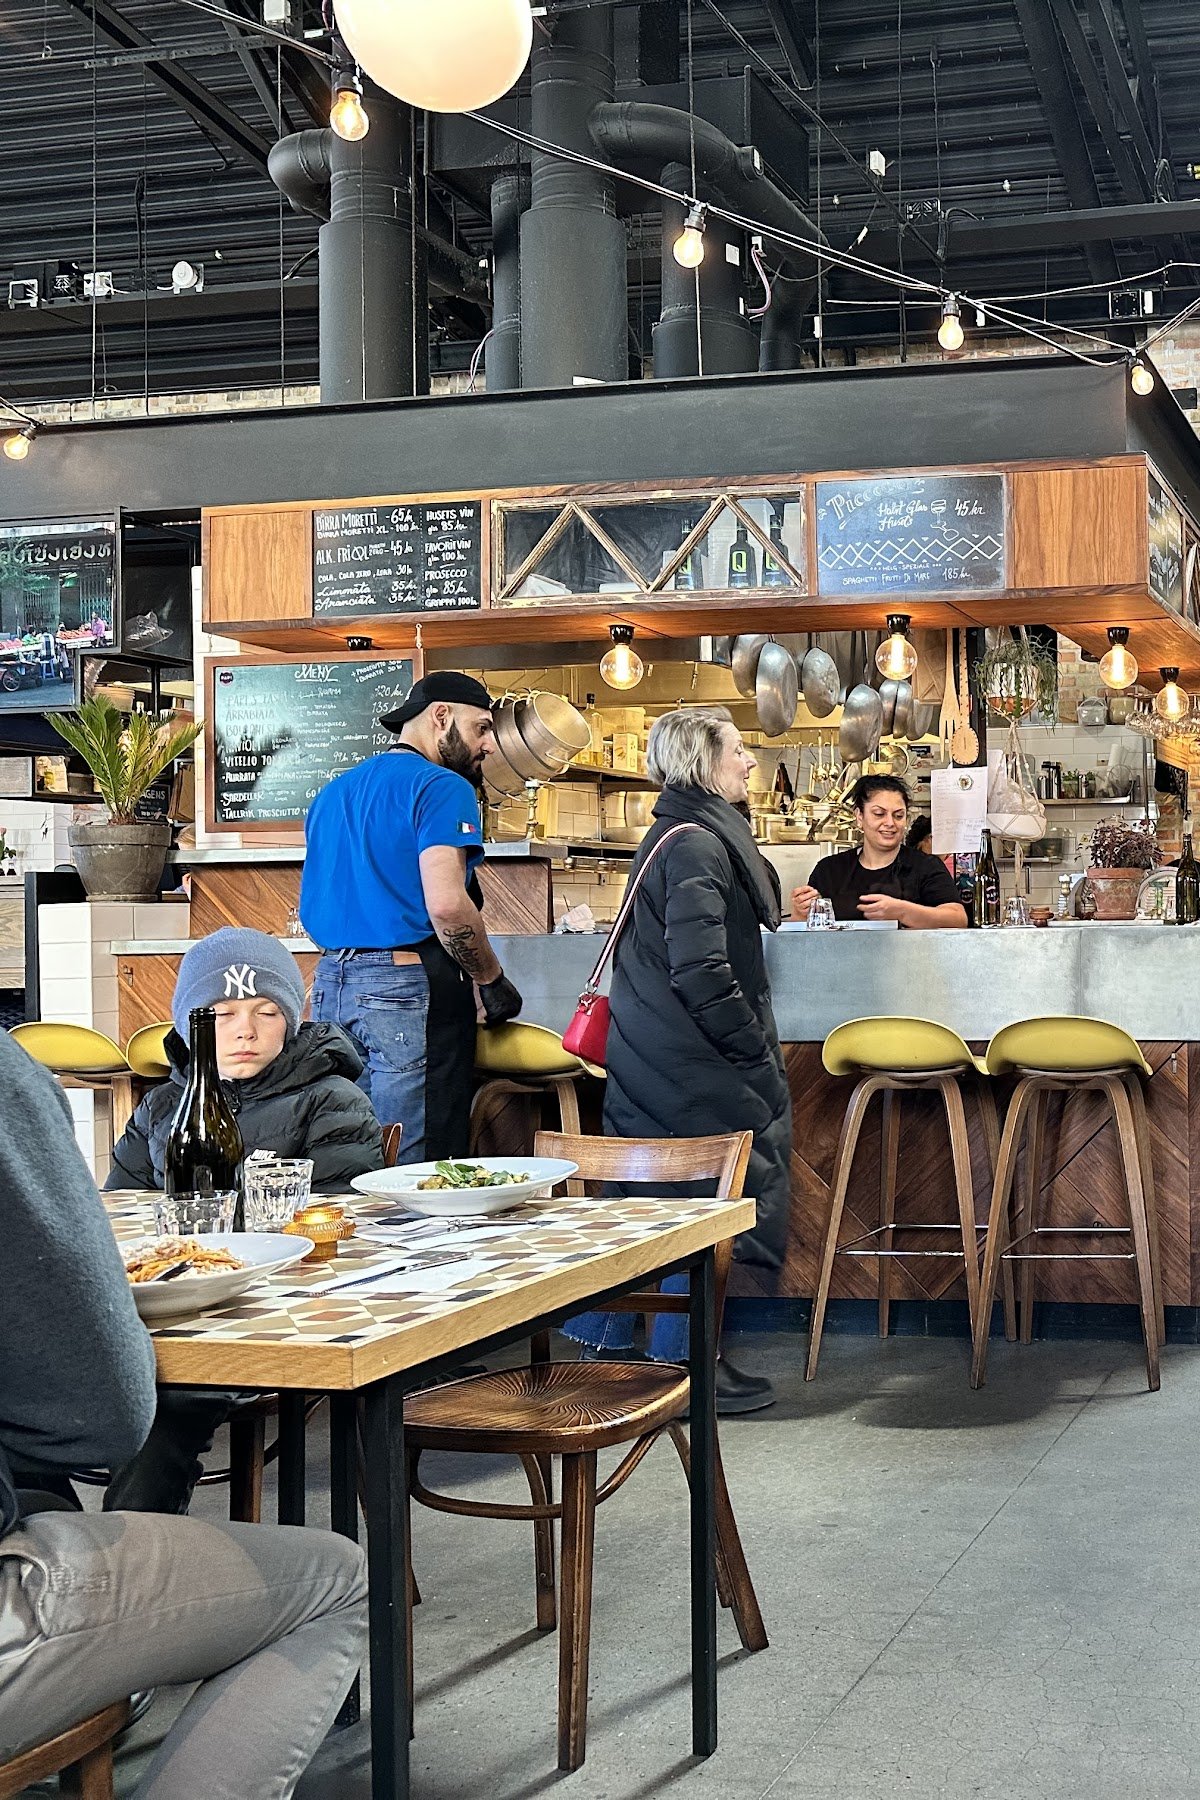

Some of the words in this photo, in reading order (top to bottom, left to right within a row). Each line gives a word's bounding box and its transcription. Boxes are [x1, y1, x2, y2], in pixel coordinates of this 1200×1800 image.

[954, 499, 969, 516] 45
[426, 509, 457, 521] HUSETS
[375, 525, 389, 534] XL
[441, 520, 454, 531] 85
[441, 552, 456, 561] 100
[732, 551, 747, 572] Q
[425, 568, 467, 581] PROSECCO
[842, 576, 877, 585] SPAGHETTI
[881, 573, 901, 585] FRUTTI
[914, 572, 930, 584] MARE
[942, 567, 959, 581] 185
[391, 581, 405, 592] 35
[443, 580, 457, 594] 85
[388, 592, 404, 604] 35
[294, 664, 339, 682] MENY
[372, 700, 389, 713] 135
[372, 733, 387, 746] 150
[140, 789, 166, 800] AGENS
[305, 788, 316, 799] 60
[223, 963, 258, 999] NY
[250, 1149, 277, 1160] NIKE
